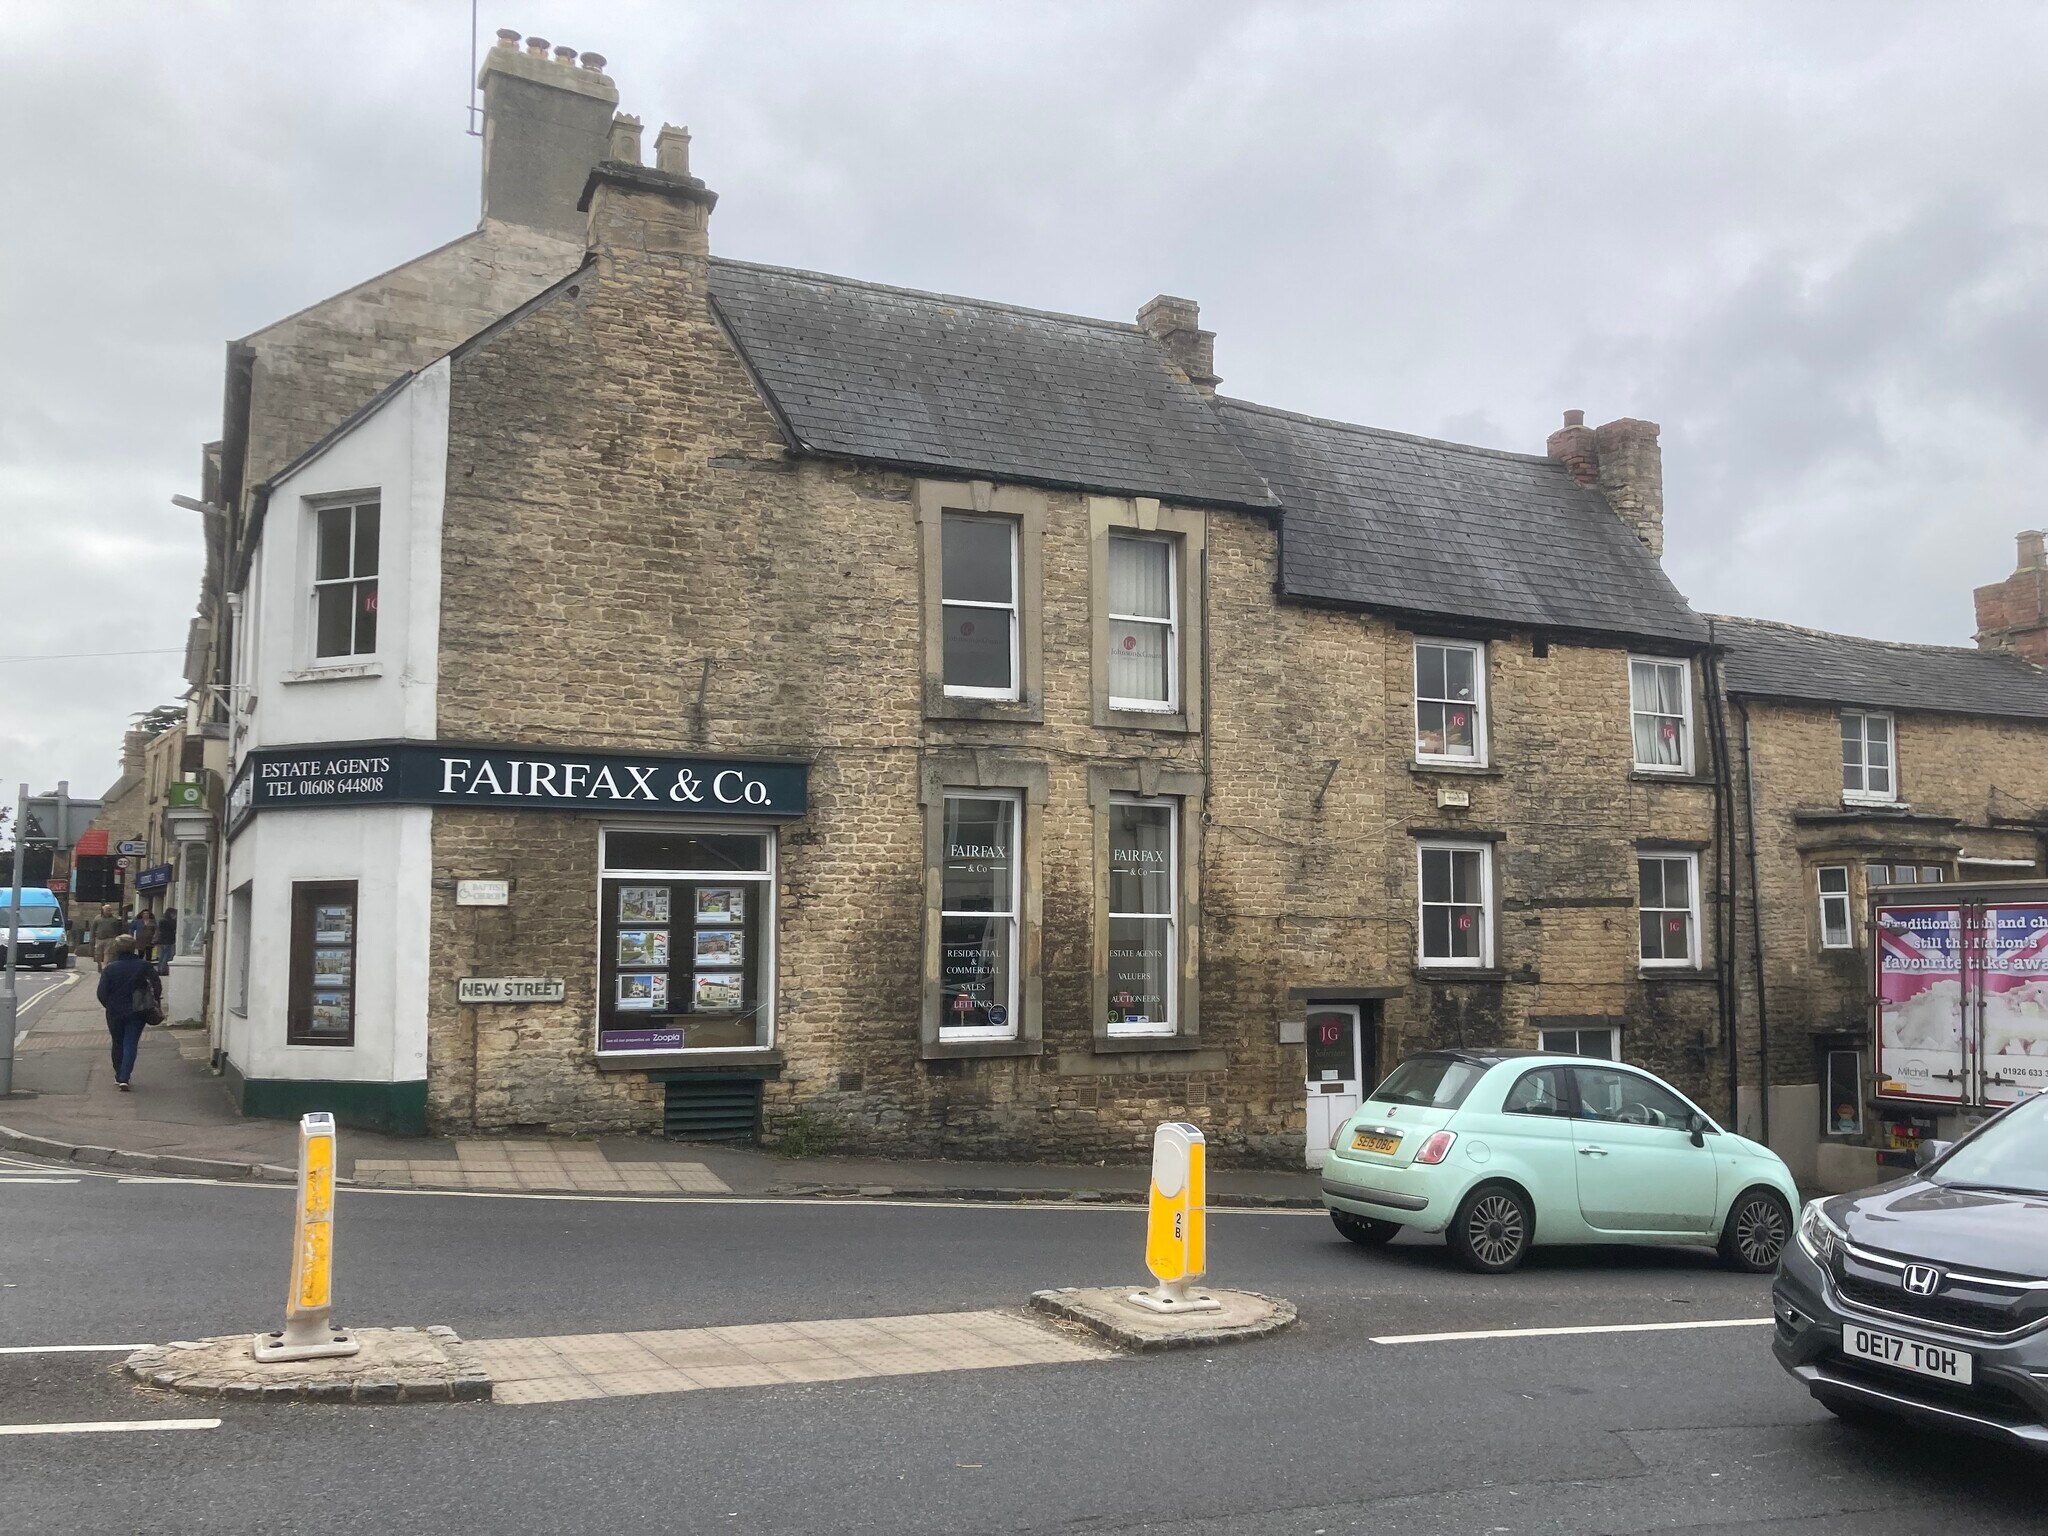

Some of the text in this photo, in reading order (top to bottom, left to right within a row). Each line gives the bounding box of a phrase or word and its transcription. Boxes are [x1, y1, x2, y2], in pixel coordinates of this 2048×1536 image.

[261, 757, 390, 778] ESTATE AGENTS
[266, 777, 384, 797] TEL 01608 644808
[439, 757, 772, 806] FAIRFAX & Co.
[950, 844, 1006, 858] FAIRFAX
[1113, 849, 1164, 862] FAIRFAX
[968, 864, 988, 873] & Co
[1129, 867, 1148, 876] & Co
[1998, 915, 2027, 929] and
[1913, 936, 2038, 949] still the Nation's
[947, 949, 1001, 957] RESIDENTIAL
[1109, 949, 1163, 957] ESTATE AGENTS
[1884, 955, 1962, 970] favourite
[946, 966, 1001, 974] COMMERCIAL
[1118, 972, 1151, 980] VALUERS
[461, 982, 563, 996] NEW STREET
[961, 983, 986, 991] SALES
[970, 992, 977, 1000] &
[1110, 995, 1161, 1003] AUCTIONEERS
[954, 1000, 993, 1009] LETTINGS
[652, 1033, 680, 1042] Zoopla
[1321, 1026, 1338, 1042] JG
[1897, 1066, 1929, 1078] Mitchell
[2002, 1067, 2026, 1076] 01926
[2028, 1068, 2043, 1077] 633
[1357, 1135, 1375, 1147] SE15
[1176, 1213, 1182, 1224] 2
[1175, 1227, 1181, 1238] B
[1856, 1330, 1956, 1376] OE17 TOH
